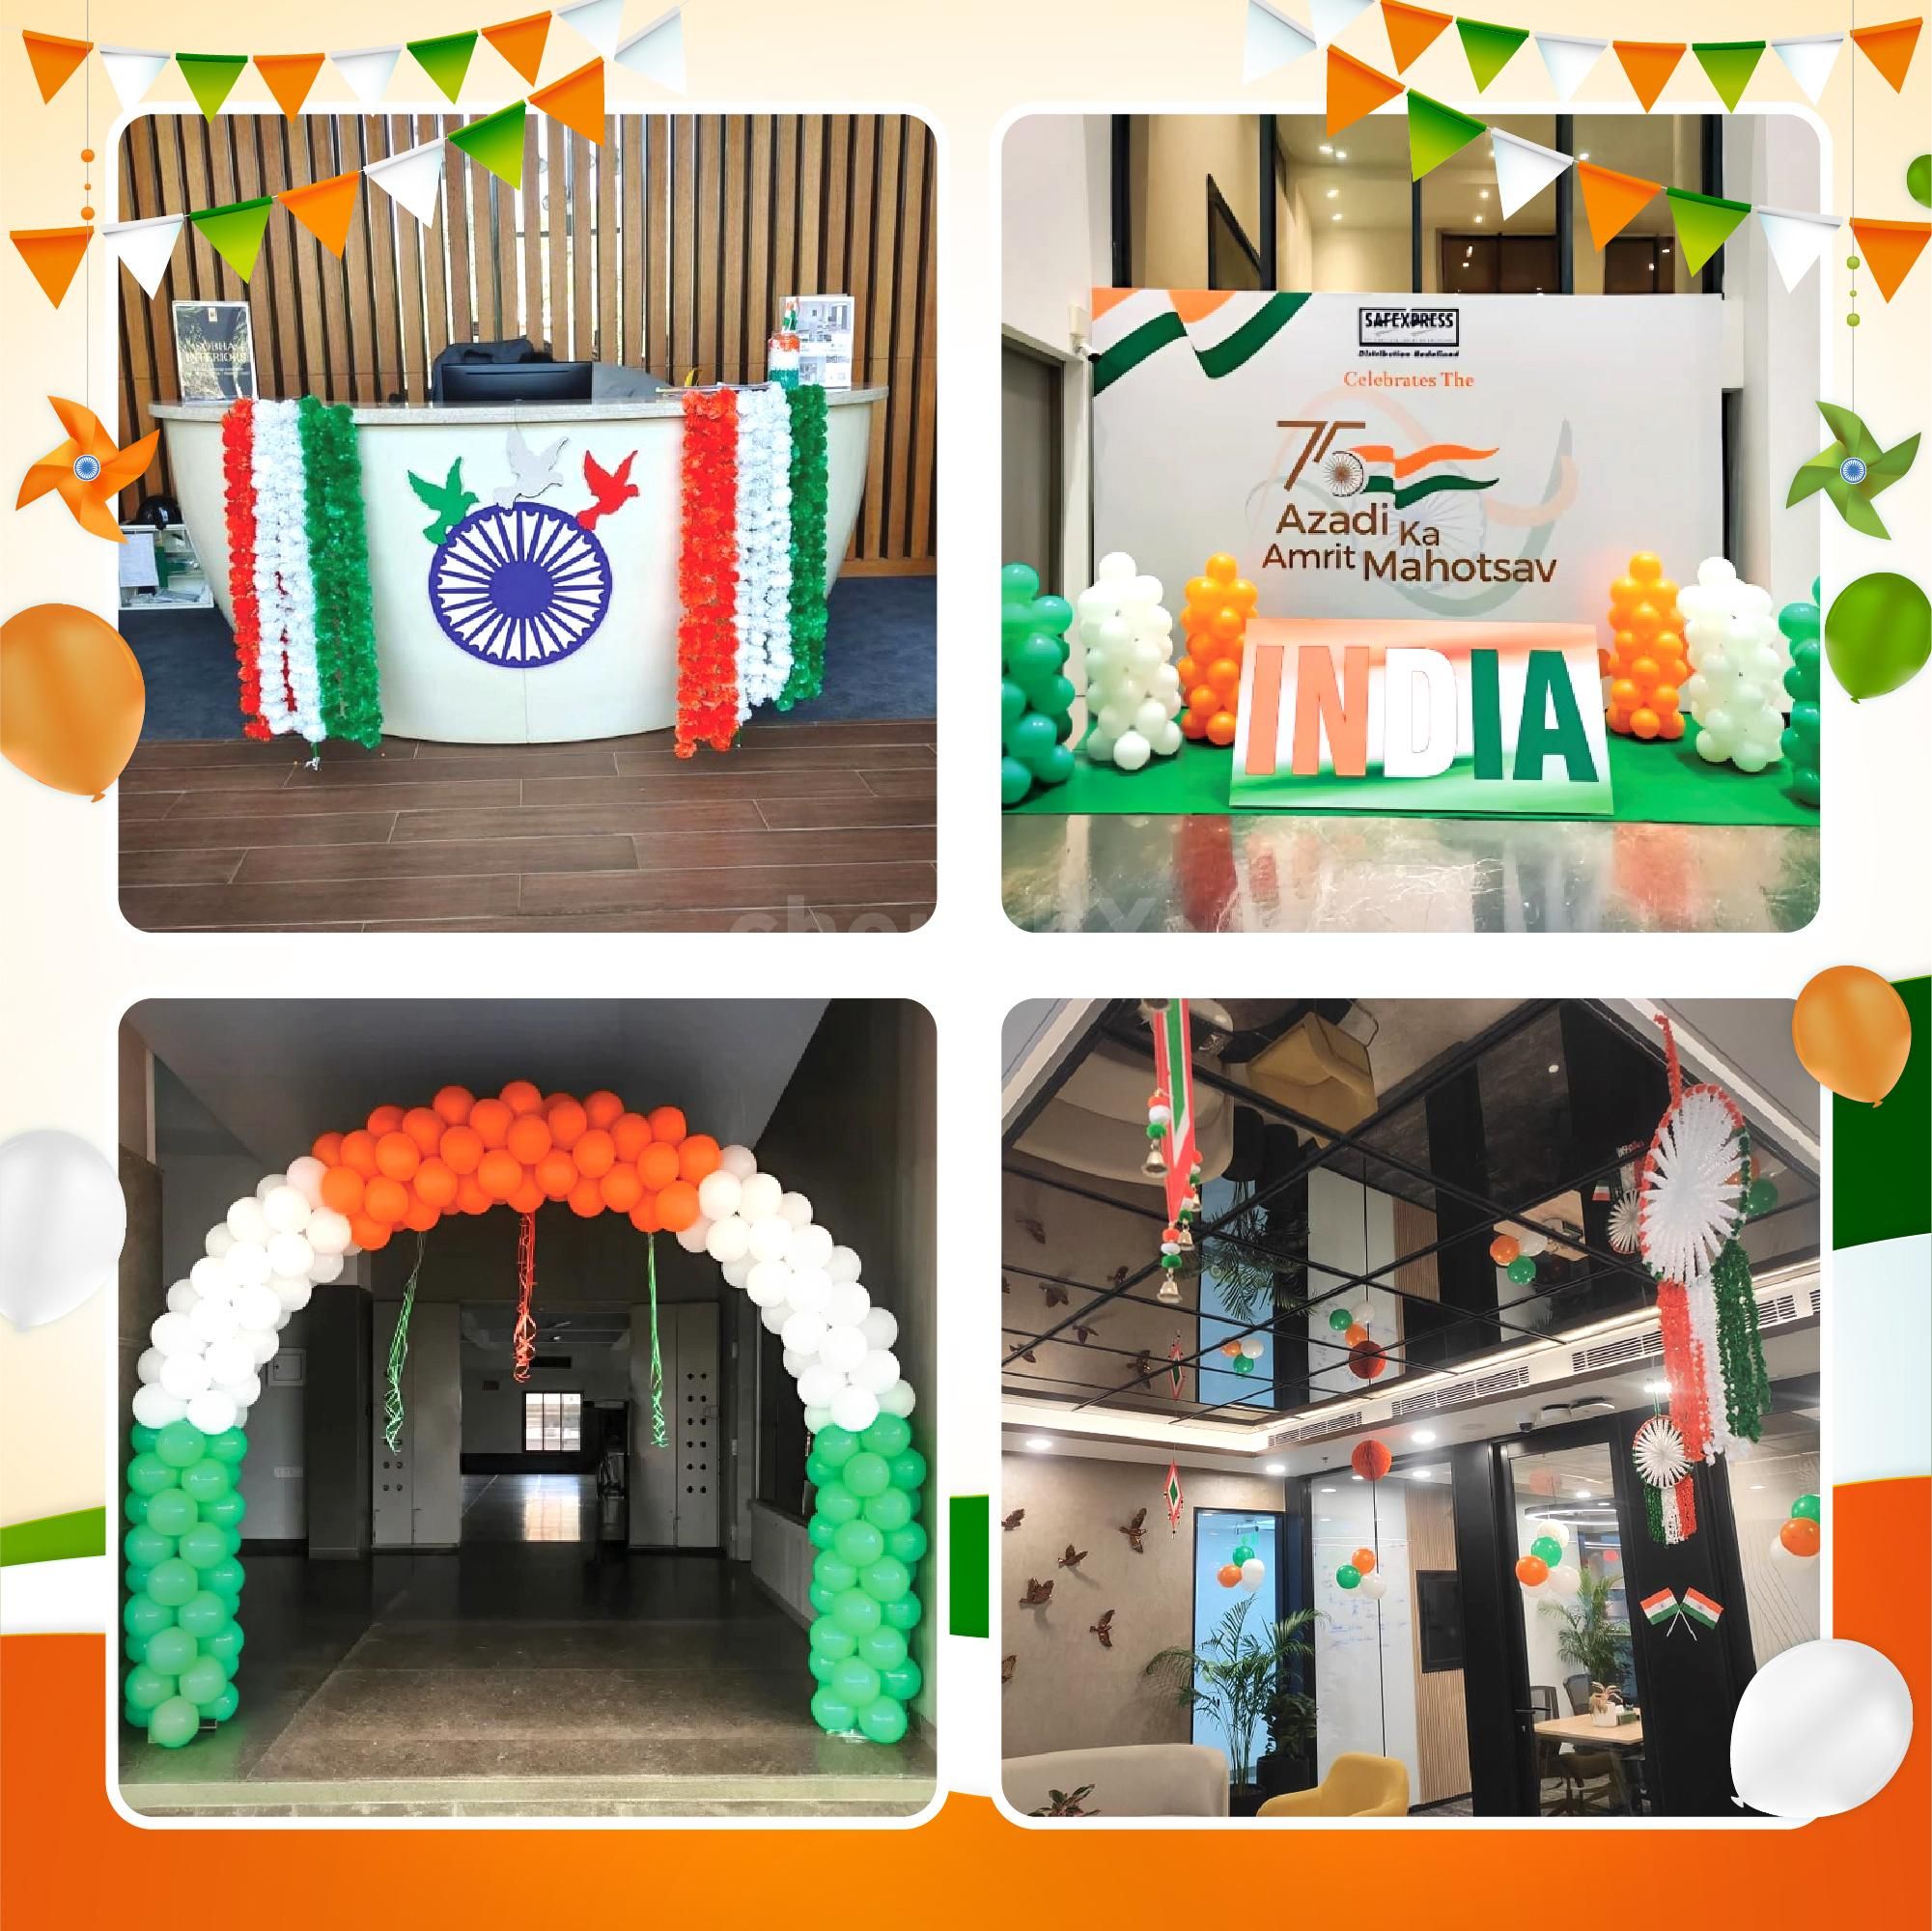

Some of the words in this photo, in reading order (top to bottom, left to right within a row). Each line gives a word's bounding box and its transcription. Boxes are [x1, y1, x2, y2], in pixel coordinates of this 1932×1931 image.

[1365, 312, 1454, 328] SAFEXPRESS
[1343, 370, 1437, 387] Celebrates
[1441, 371, 1475, 387] The
[1276, 420, 1366, 498] 75
[1275, 502, 1388, 536] Azadi
[1399, 520, 1440, 546] Ka
[1262, 543, 1356, 570] Amrit
[1362, 548, 1557, 583] Mahotsav
[1246, 645, 1600, 783] INDIA
